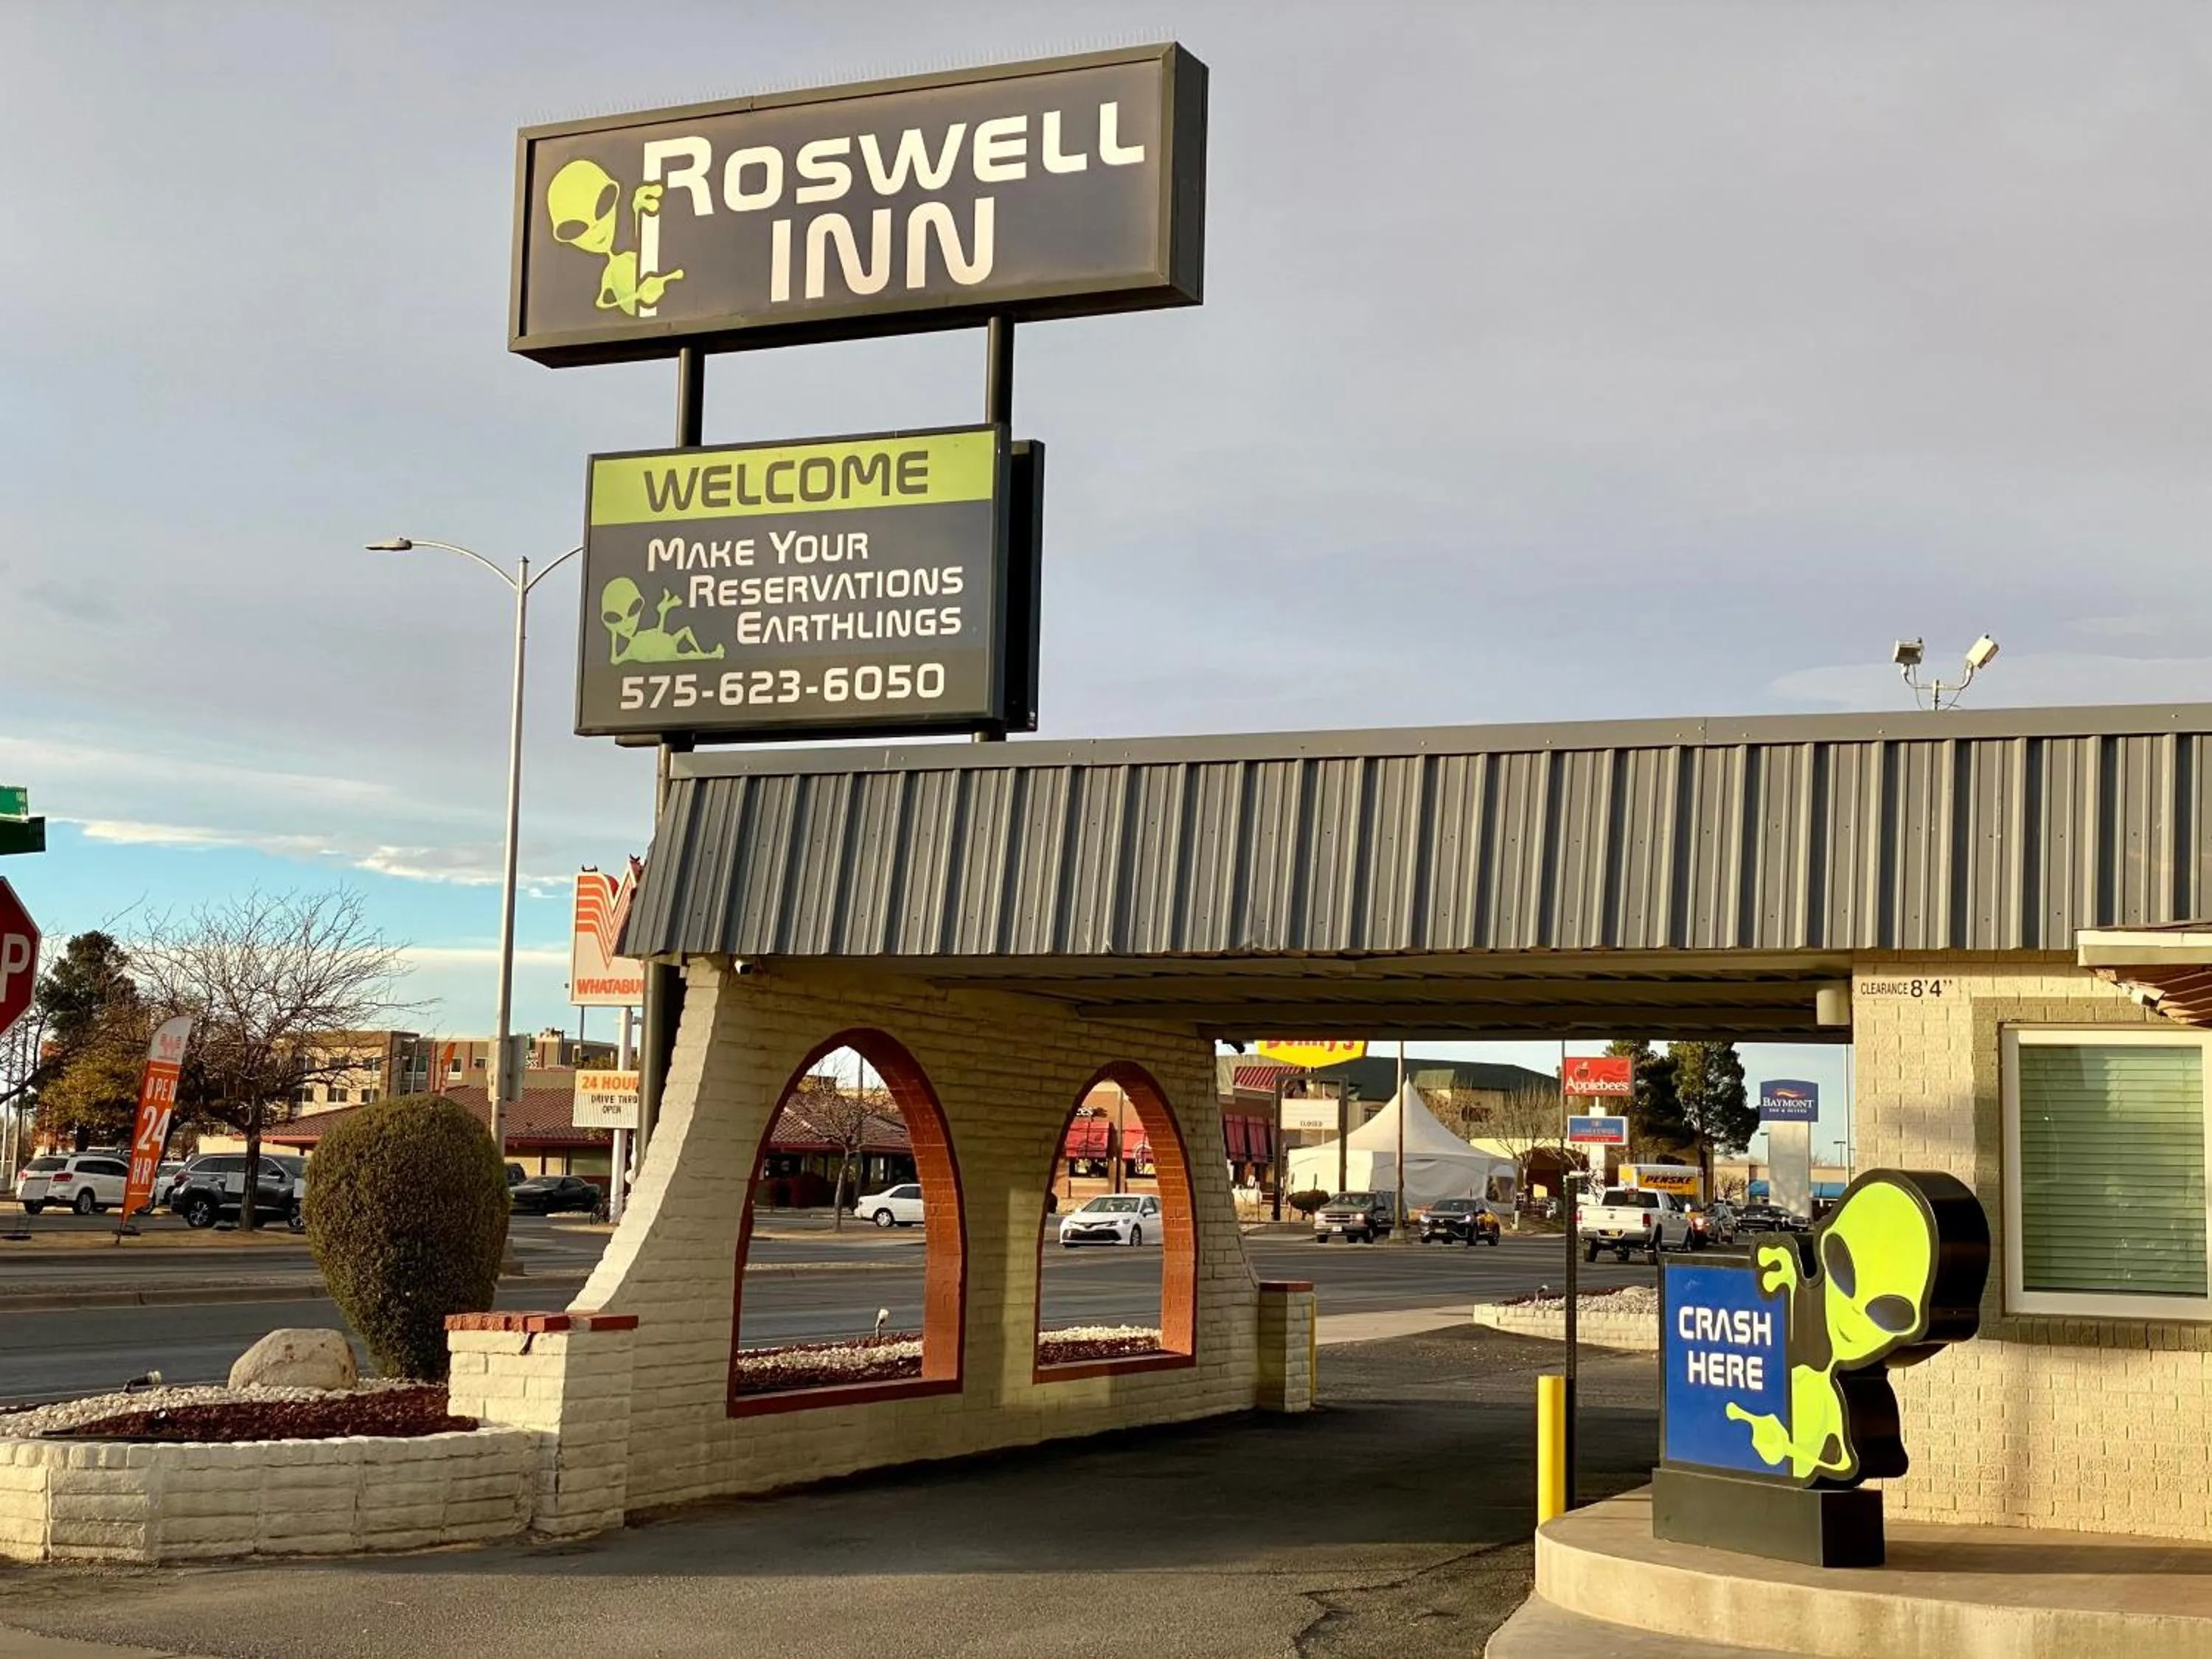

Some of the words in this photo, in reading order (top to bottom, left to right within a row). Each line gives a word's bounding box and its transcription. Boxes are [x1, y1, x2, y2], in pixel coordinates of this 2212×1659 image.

[643, 101, 1145, 217] ROSWELL
[770, 197, 995, 303] INN
[644, 449, 929, 513] WELCOME
[647, 537, 755, 573] MAKE
[768, 529, 869, 566] YOUR
[687, 565, 964, 609] RESERVATIONS
[736, 606, 963, 646] EARTHLINGS
[619, 662, 945, 711] 575-623-6050
[1860, 981, 1908, 995] CLEARANCE
[145, 1076, 178, 1102] OPEN
[582, 1076, 597, 1089] 24
[1763, 1096, 1815, 1108] BAYMONT
[136, 1105, 173, 1151] 24
[1678, 1305, 1772, 1346] CRASH
[1687, 1350, 1764, 1391] HERE
